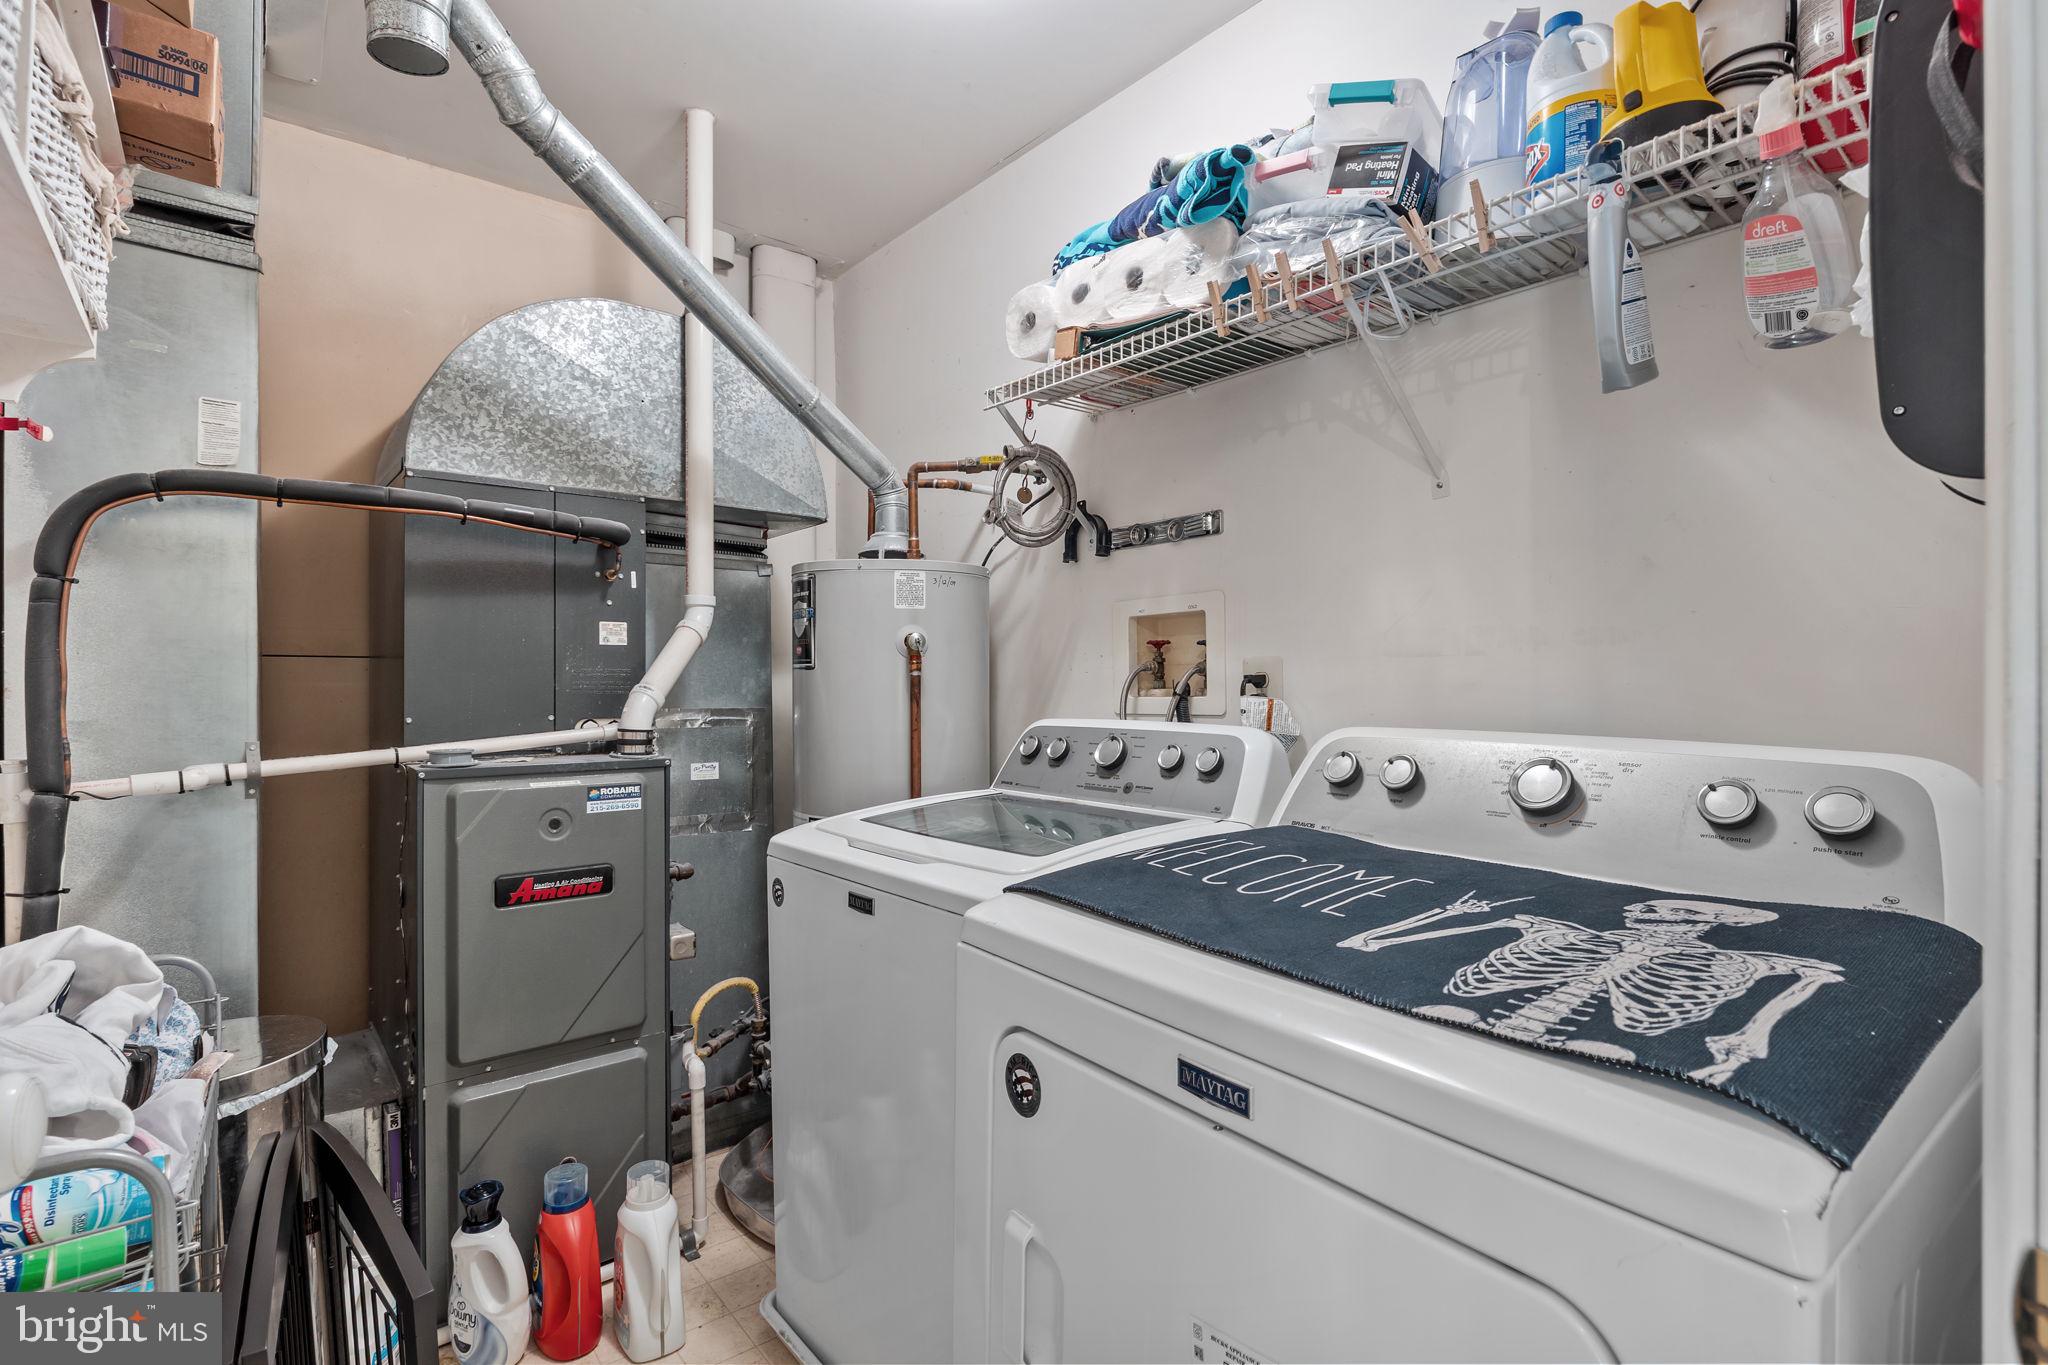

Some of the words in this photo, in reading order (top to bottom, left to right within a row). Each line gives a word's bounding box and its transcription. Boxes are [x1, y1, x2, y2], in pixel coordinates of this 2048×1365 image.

[1345, 162, 1365, 172] Pad
[1364, 160, 1400, 171] Heating
[1376, 170, 1397, 180] Mini
[1752, 219, 1789, 238] dreft
[600, 786, 641, 795] ROBAIRE
[1291, 820, 1316, 829] BRAVOS
[1699, 832, 1725, 841] wrinkle
[1726, 835, 1752, 844] control
[1812, 845, 1833, 855] push
[1833, 847, 1843, 855] to
[1843, 849, 1864, 858] start
[1115, 838, 1435, 918] WELCOME
[507, 876, 604, 905] Amana
[1180, 1065, 1248, 1111] MAYTAG
[389, 1113, 400, 1129] 3M
[59, 1175, 73, 1197] Spray
[43, 1176, 60, 1228] Disinfectant
